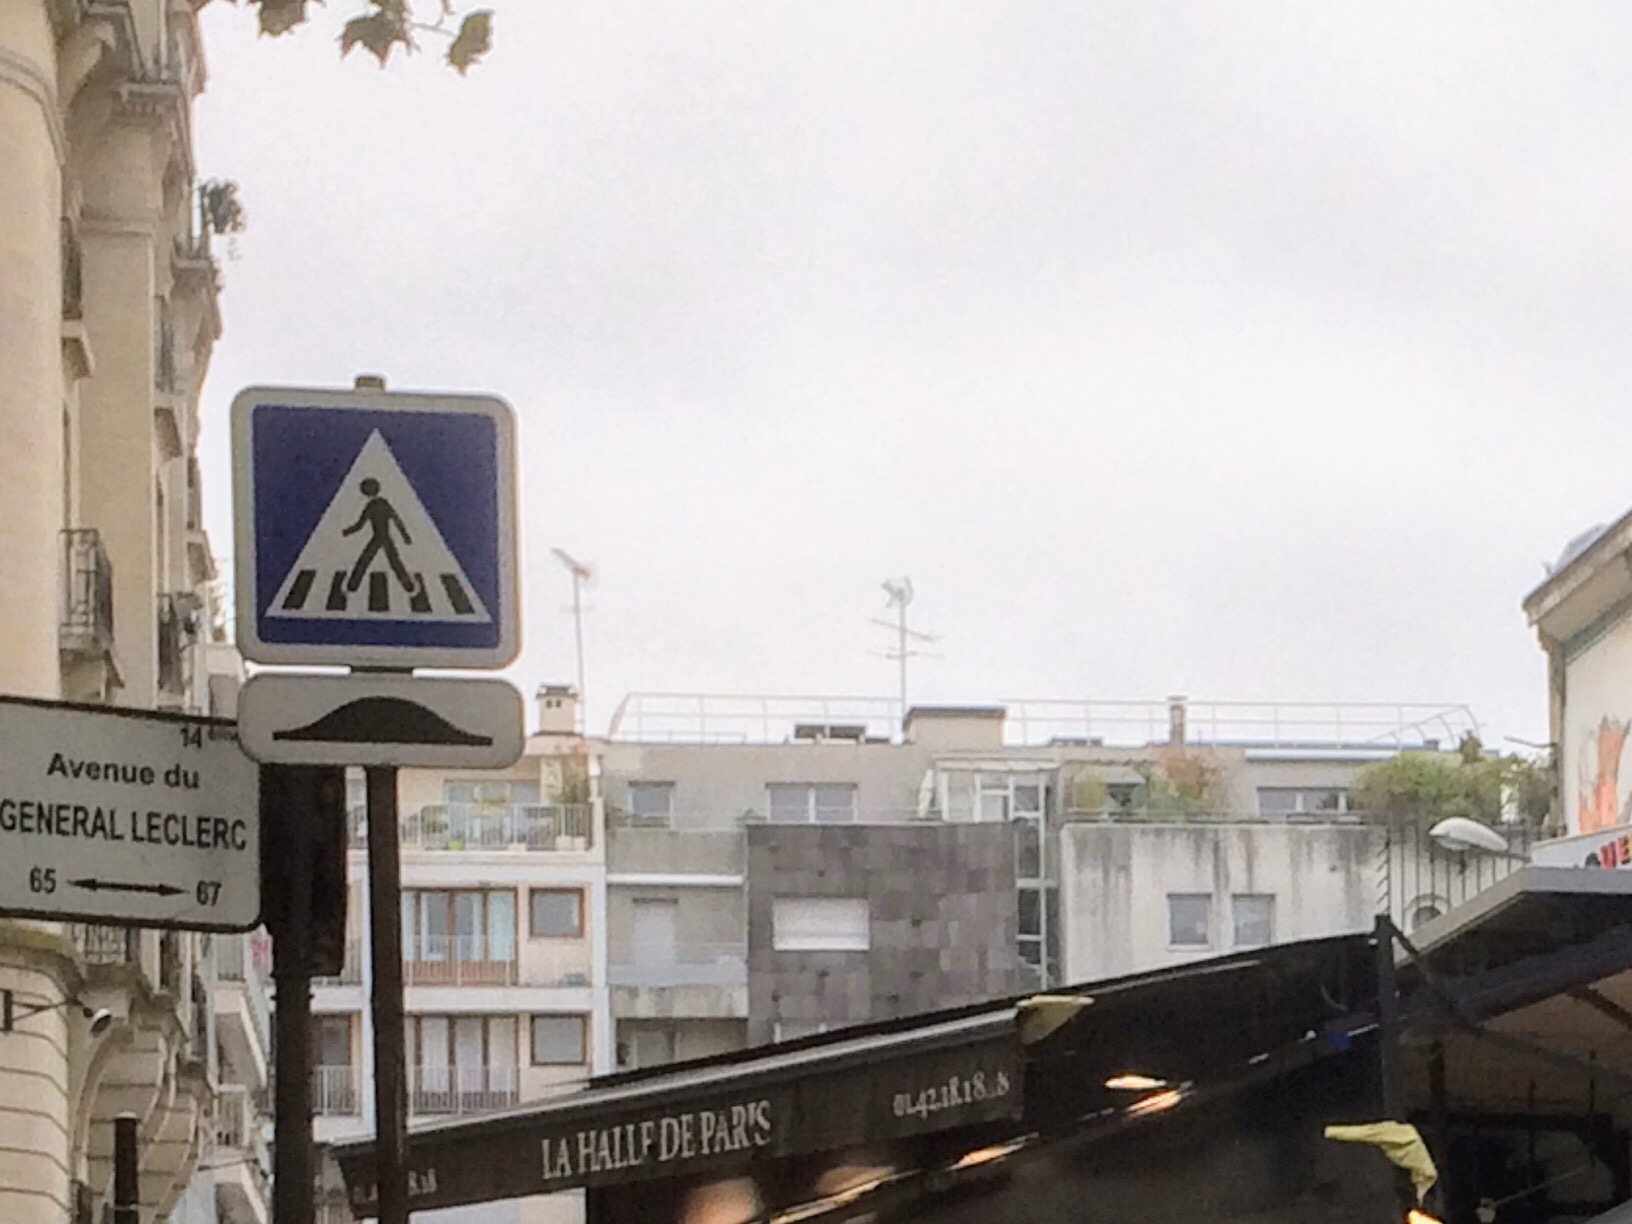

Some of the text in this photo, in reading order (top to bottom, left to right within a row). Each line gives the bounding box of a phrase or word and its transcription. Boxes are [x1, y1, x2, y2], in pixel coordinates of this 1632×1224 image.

[181, 725, 202, 749] 14
[47, 752, 200, 790] Avenue du
[0, 799, 247, 851] GENERAL LECLERC
[30, 867, 56, 894] 65
[196, 880, 222, 906] 67
[541, 1138, 573, 1179] LA
[658, 1113, 697, 1162] DE
